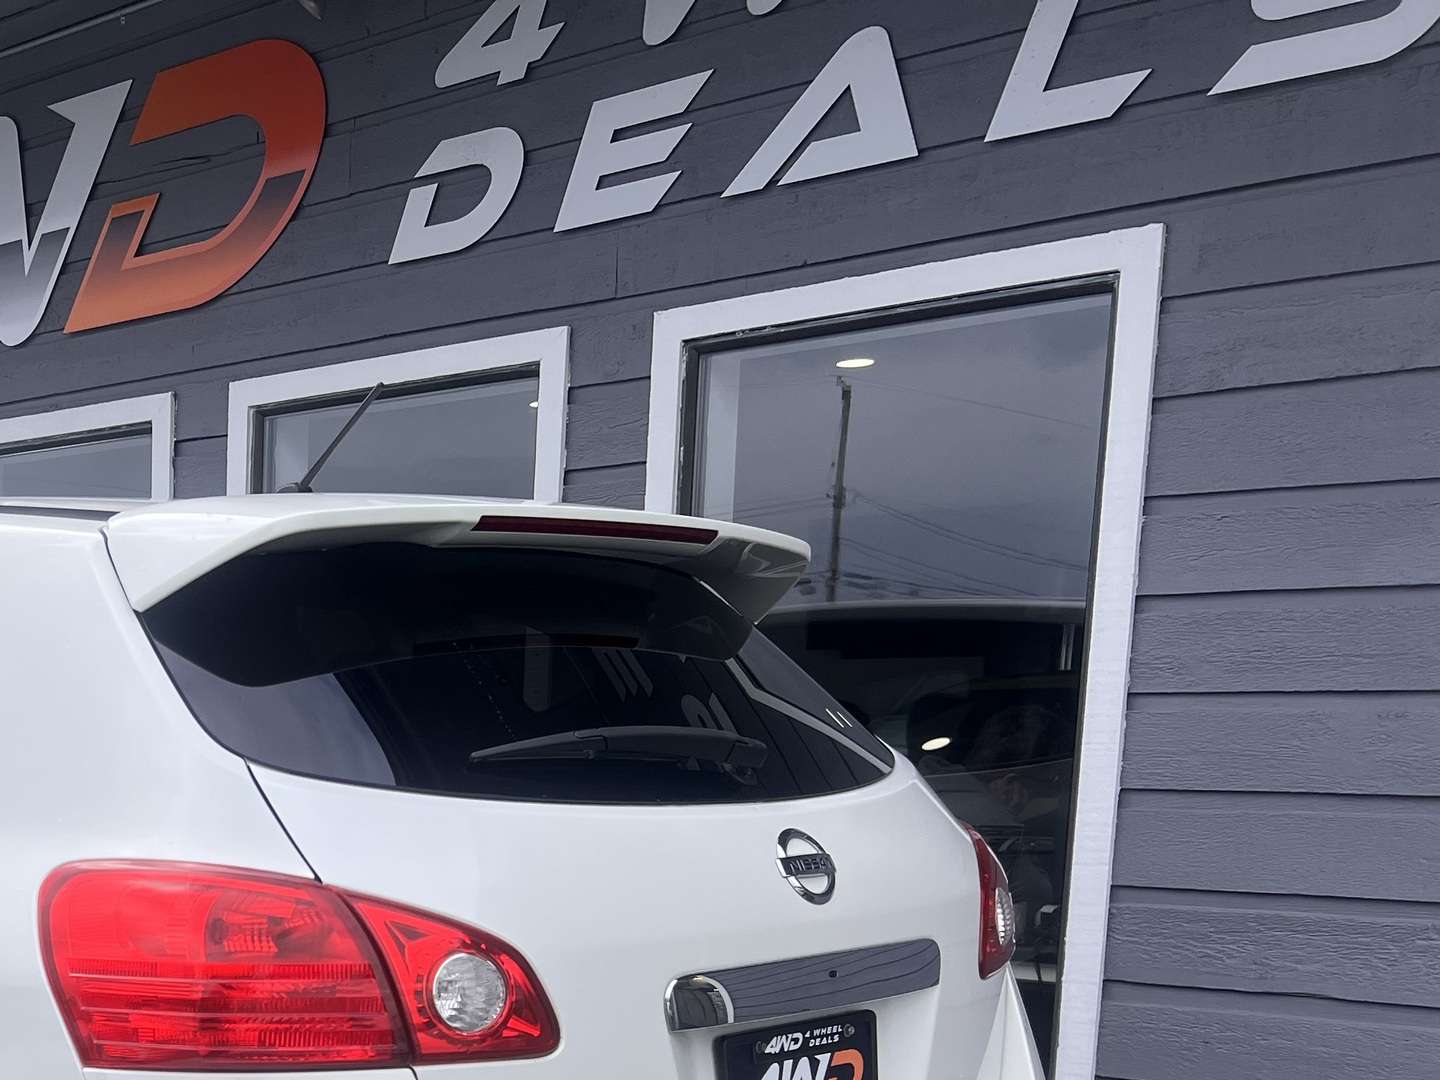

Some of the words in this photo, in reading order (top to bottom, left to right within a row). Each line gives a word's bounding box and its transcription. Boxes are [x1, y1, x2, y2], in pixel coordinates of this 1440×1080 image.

[764, 1032, 804, 1054] 4WD
[804, 1030, 811, 1038] 4
[813, 1024, 843, 1037] WHEEL
[808, 1034, 840, 1047] DEALS
